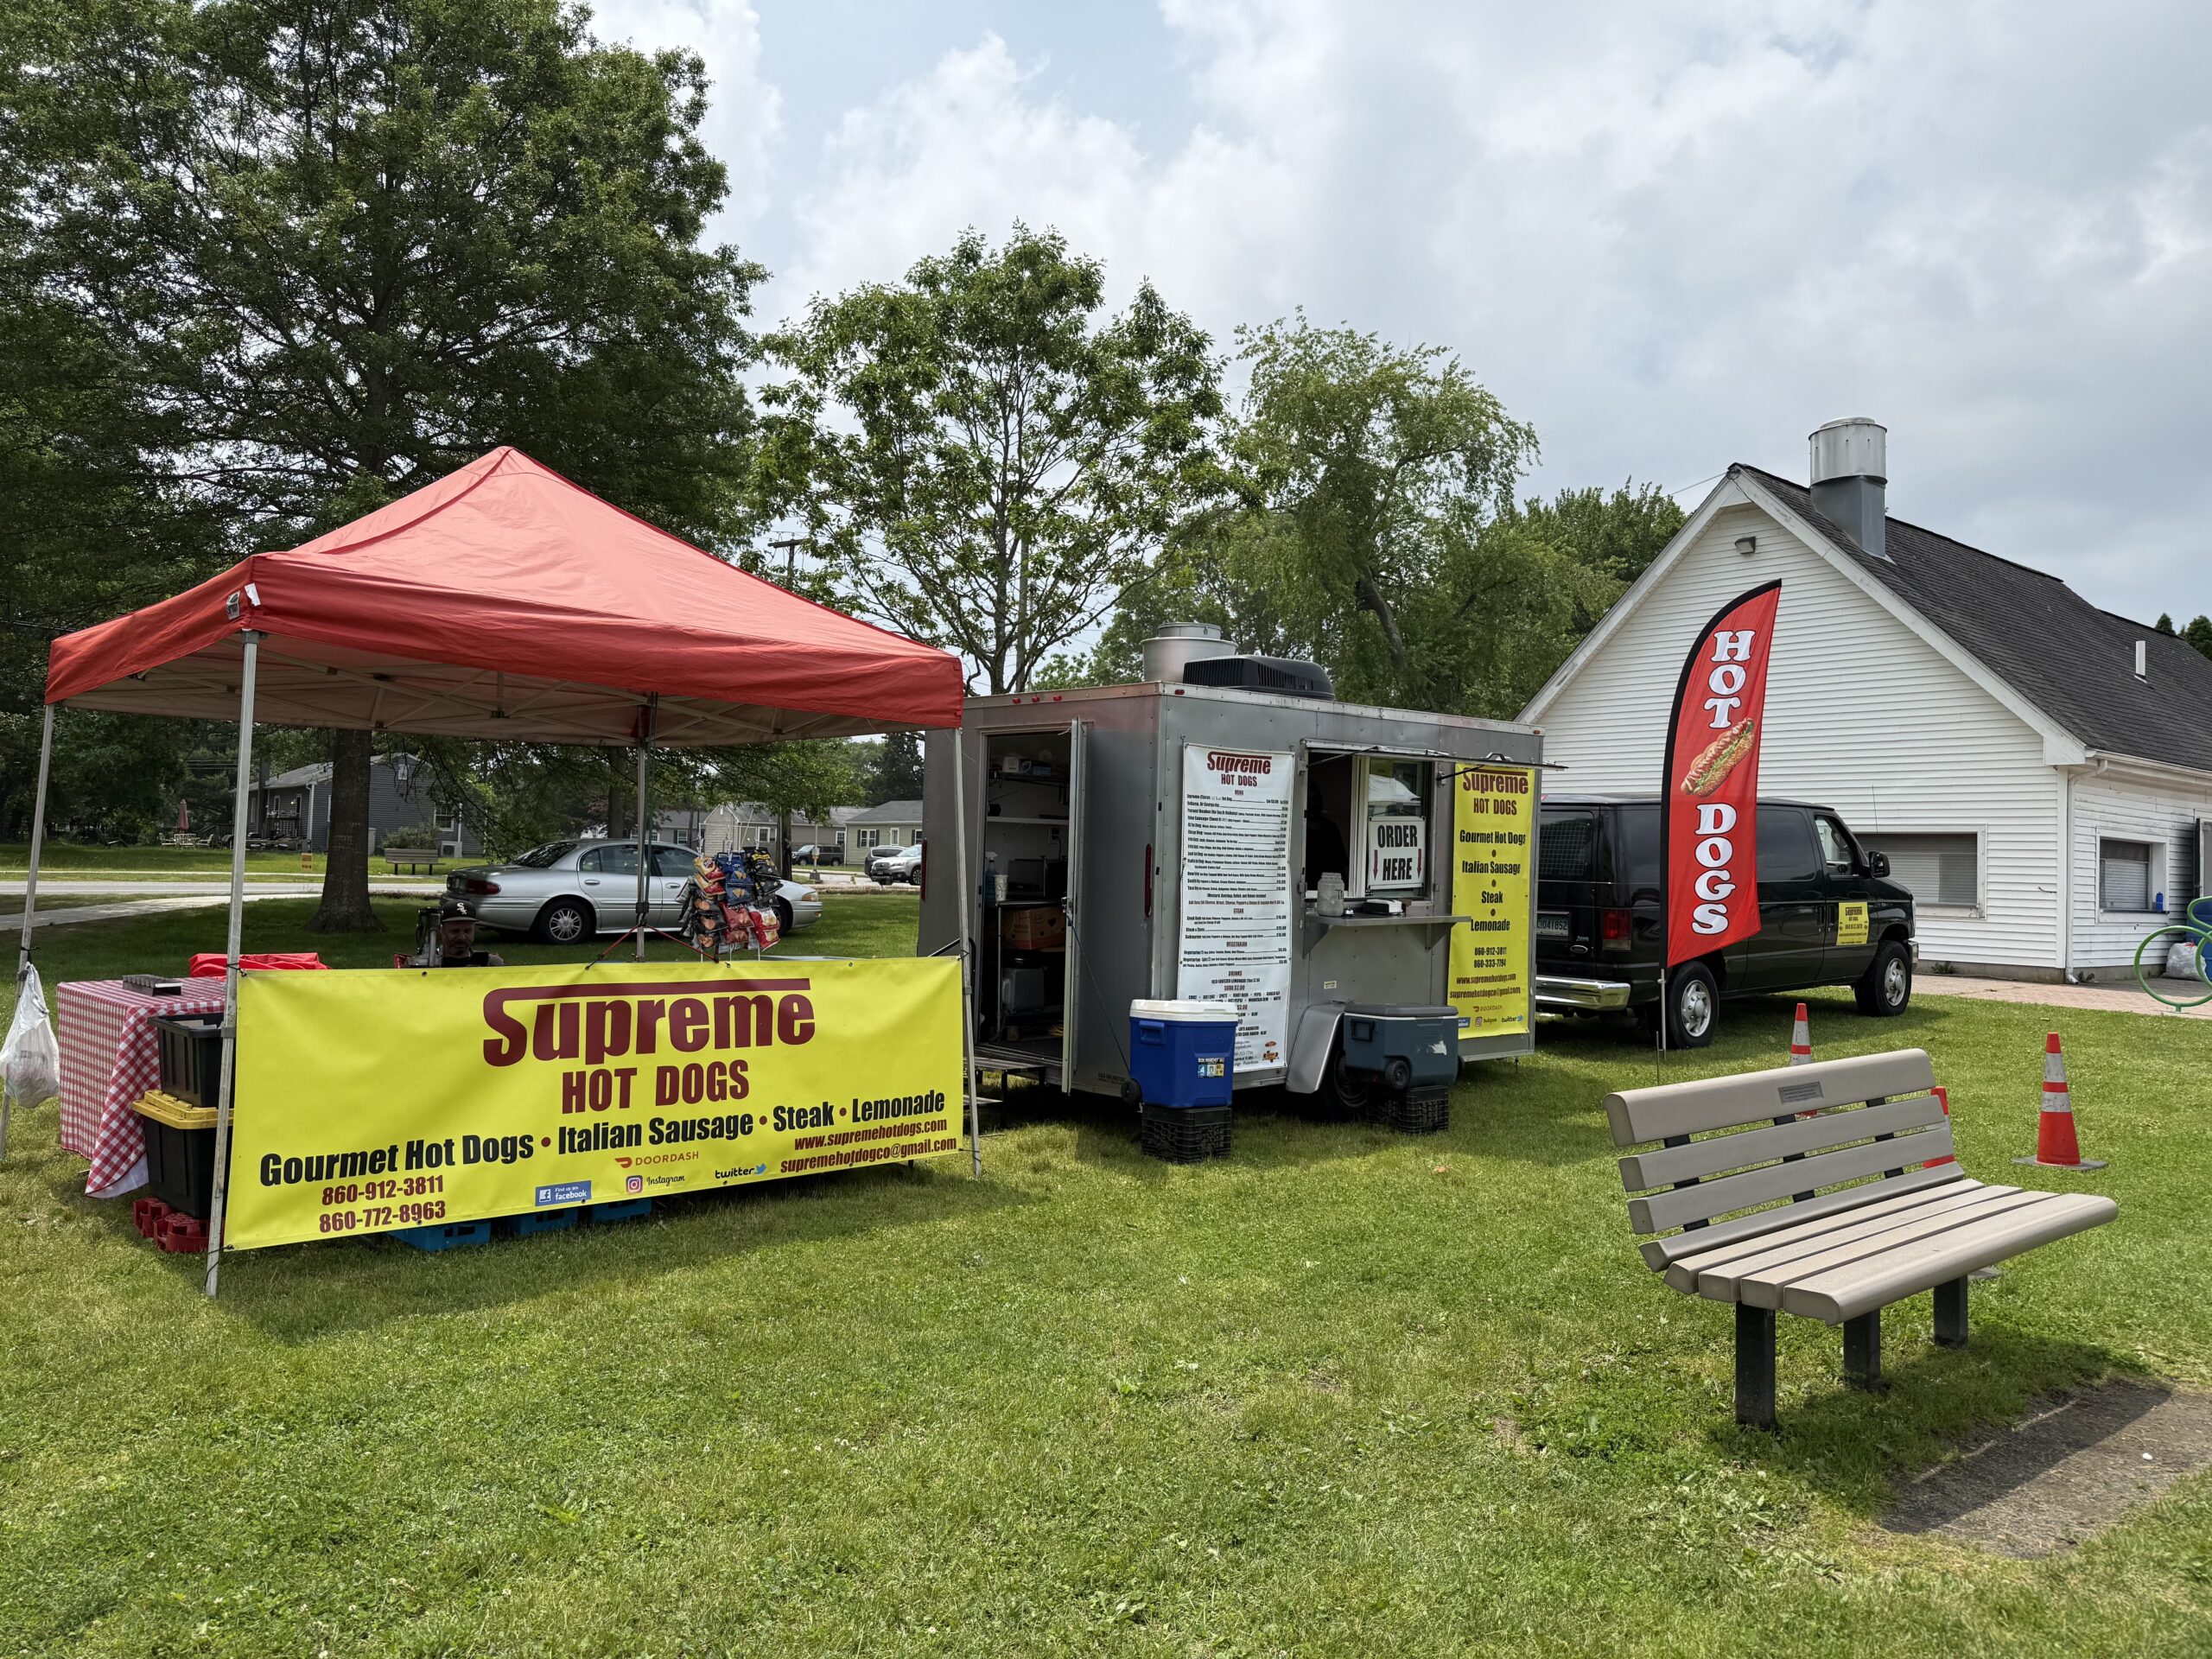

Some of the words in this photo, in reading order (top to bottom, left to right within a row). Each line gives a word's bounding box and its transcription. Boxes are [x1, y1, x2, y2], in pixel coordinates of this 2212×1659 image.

[1703, 630, 1757, 728] HOT
[1207, 752, 1272, 774] Supreme
[1221, 774, 1235, 785] HOT
[1238, 775, 1257, 786] DOGS
[1463, 767, 1529, 794] Supreme
[1473, 798, 1489, 814] HOT
[1493, 799, 1516, 815] DOGS
[1377, 825, 1417, 848] ORDER
[1460, 830, 1493, 843] Gourmet
[1495, 831, 1506, 844] Hot
[1508, 832, 1526, 846] Dogs
[1382, 858, 1412, 880] HERE
[1462, 861, 1488, 874] Italian
[1491, 861, 1521, 875] Sausage
[1691, 803, 1737, 936] DOGS
[1481, 891, 1503, 905] Steak
[1471, 918, 1510, 931] Lemonade
[483, 977, 816, 1067] Supreme
[562, 1067, 638, 1115] HOT
[655, 1059, 749, 1107] DOGS
[260, 1145, 398, 1187] Gourmet
[405, 1139, 455, 1171] Hot
[462, 1134, 534, 1165] Dogs
[559, 1122, 642, 1154] Italian
[649, 1113, 753, 1146] Sausage
[773, 1102, 835, 1132] Steak
[852, 1090, 945, 1123] Lemonade
[794, 1119, 947, 1150] www.supremehotdogs.com
[635, 1151, 699, 1166] DOORDASH
[780, 1137, 957, 1173] supremehotdogco@gmail.com
[647, 1174, 685, 1187] Instagram
[715, 1167, 754, 1179] twitter
[321, 1175, 443, 1205] 860-912-3811
[556, 1190, 587, 1201] facebook
[320, 1200, 446, 1233] 860-772-8963
